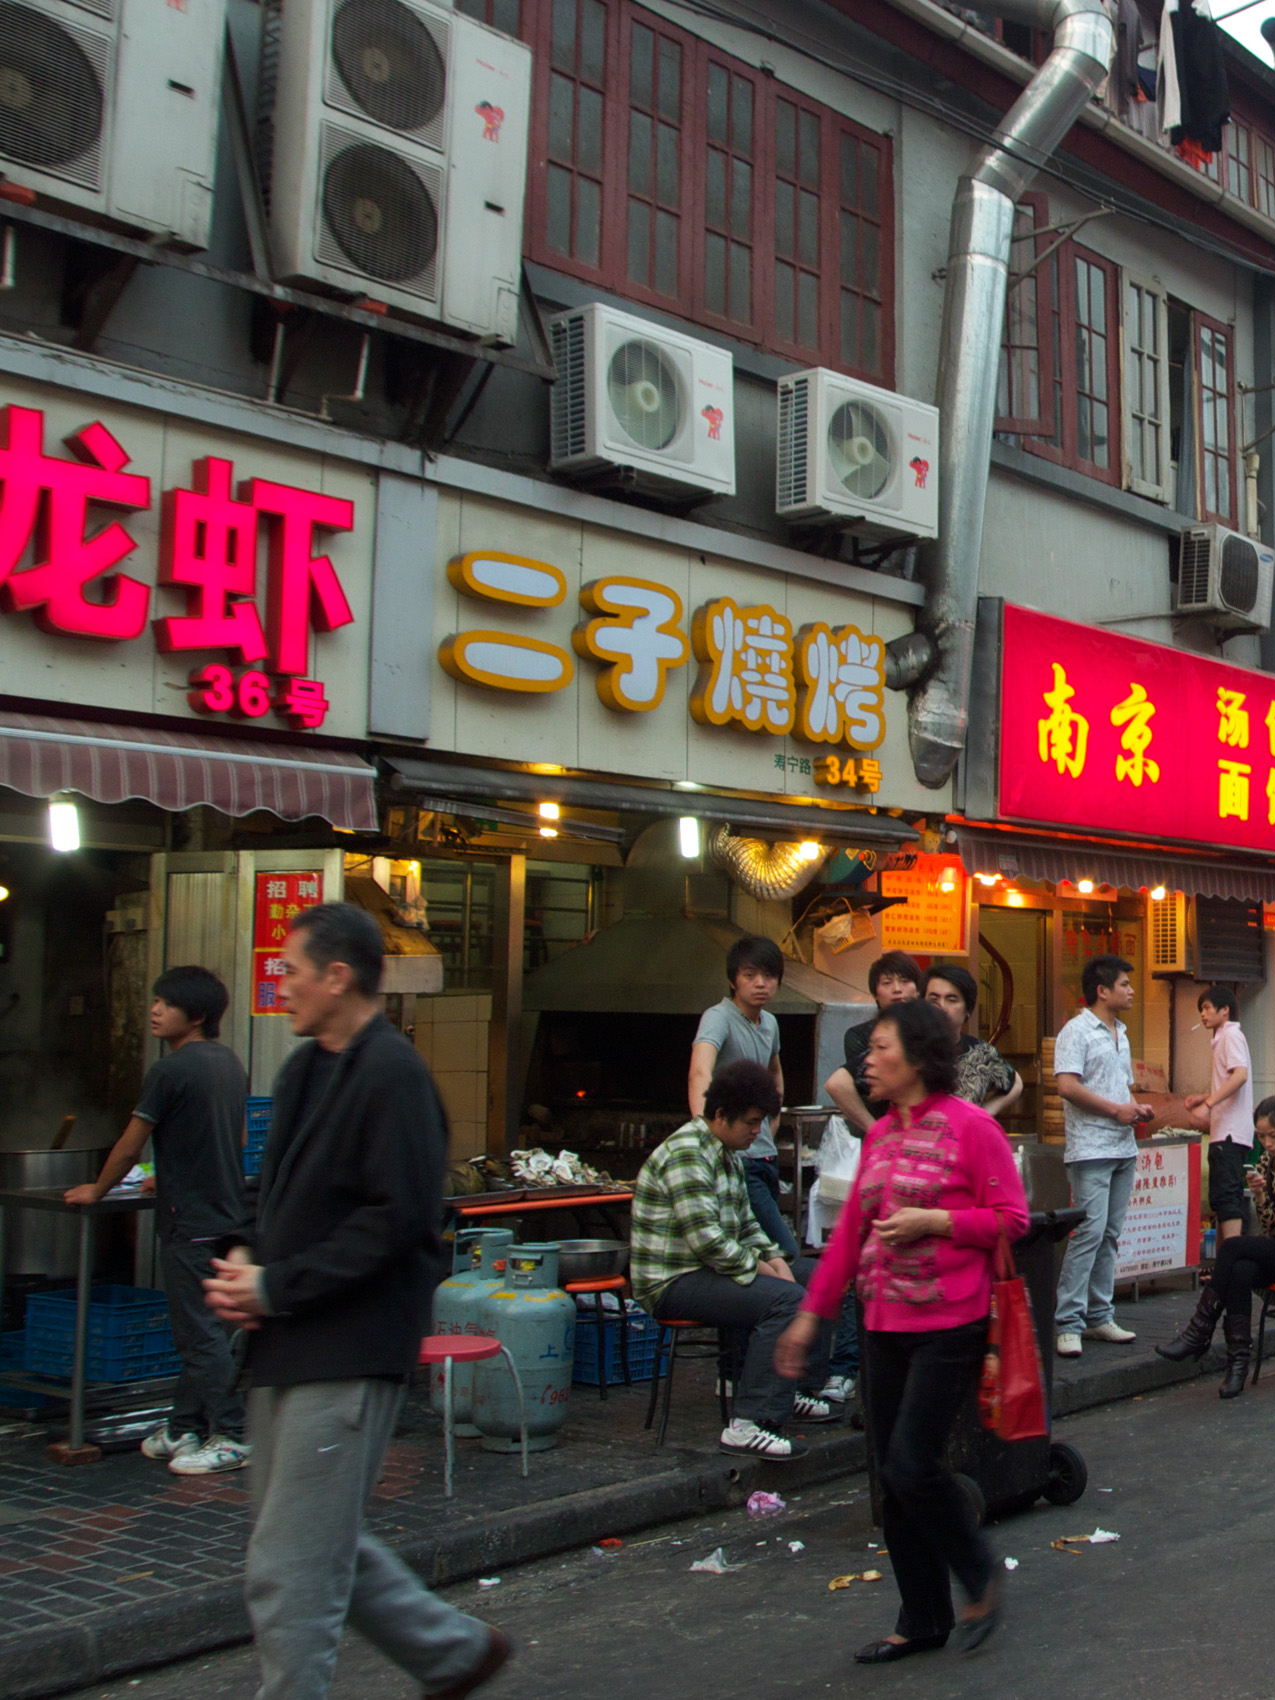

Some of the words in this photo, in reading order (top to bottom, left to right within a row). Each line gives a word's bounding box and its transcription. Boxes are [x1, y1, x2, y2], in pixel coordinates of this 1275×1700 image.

[0, 404, 354, 676] 龙虾
[188, 663, 330, 730] 36号
[438, 550, 887, 751] 二子燒烤
[1038, 662, 1160, 787] 南京
[774, 754, 811, 775] 寿宁路
[814, 754, 883, 794] 34号
[266, 880, 318, 898] 招聘
